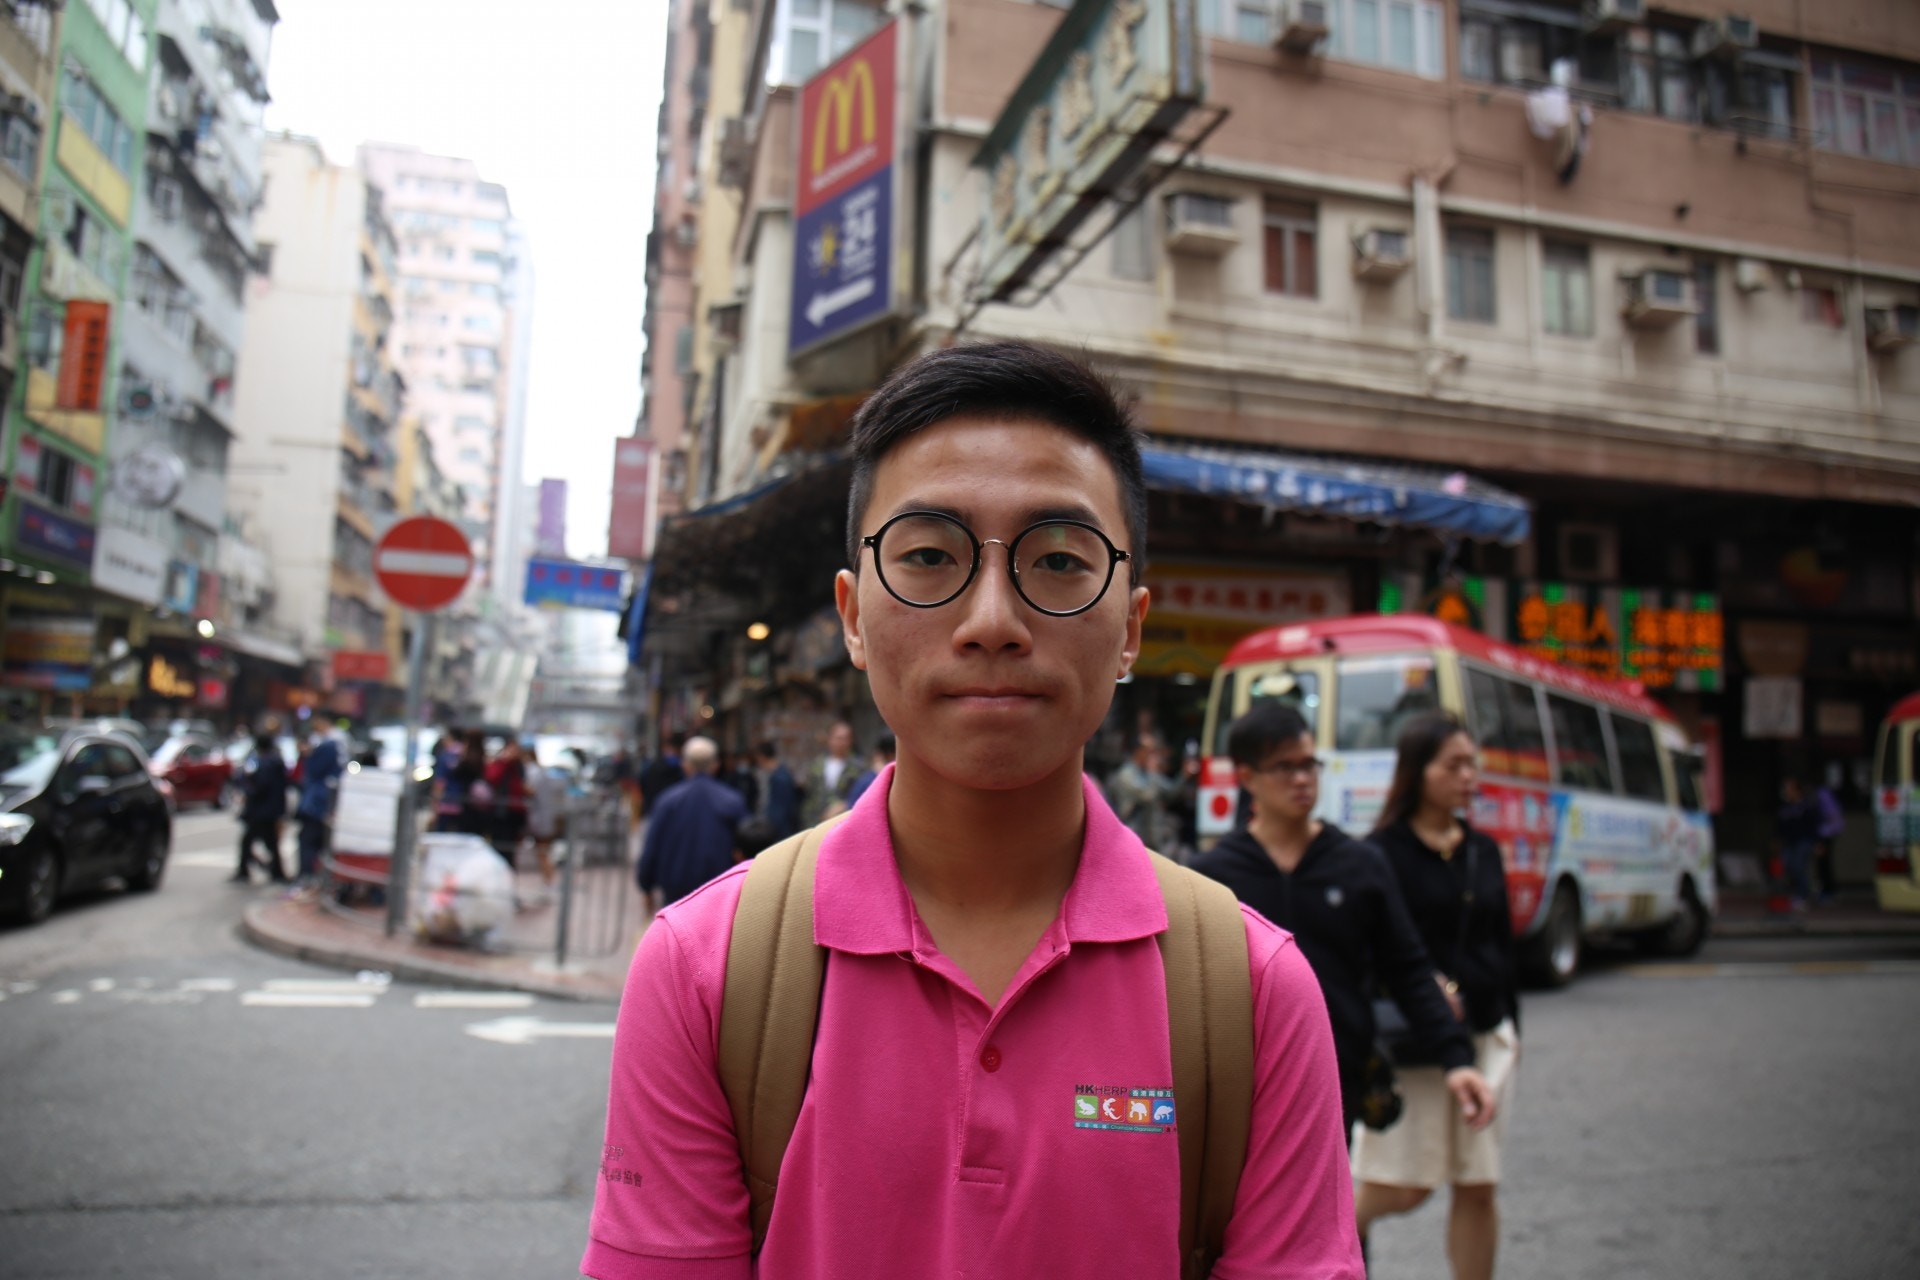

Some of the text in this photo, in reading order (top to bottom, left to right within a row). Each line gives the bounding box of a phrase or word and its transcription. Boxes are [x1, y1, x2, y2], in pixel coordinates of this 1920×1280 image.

[1132, 1089, 1174, 1097] 香港兩棲及
